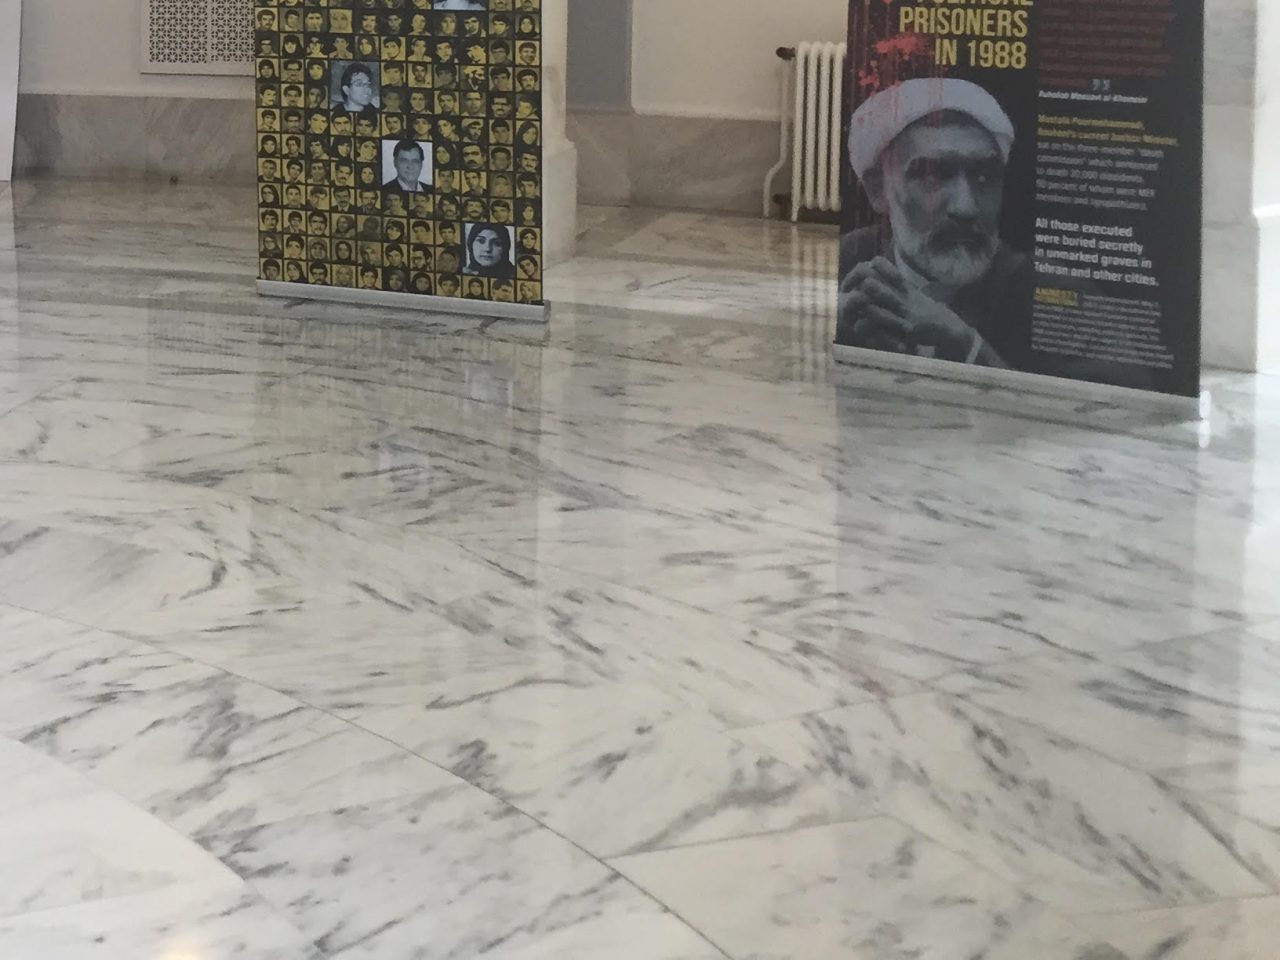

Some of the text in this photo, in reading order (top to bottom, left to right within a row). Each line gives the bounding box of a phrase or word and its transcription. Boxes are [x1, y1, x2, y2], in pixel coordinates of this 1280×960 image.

[900, 7, 1028, 38] PRISONERS
[935, 39, 1027, 69] IN 1988
[1036, 218, 1132, 237] All those executed
[1035, 234, 1143, 255] were buried secretly
[1035, 246, 1152, 268] in unmarked graves in
[1034, 262, 1068, 275] Tehran
[1071, 268, 1090, 278] and
[1093, 270, 1122, 281] other
